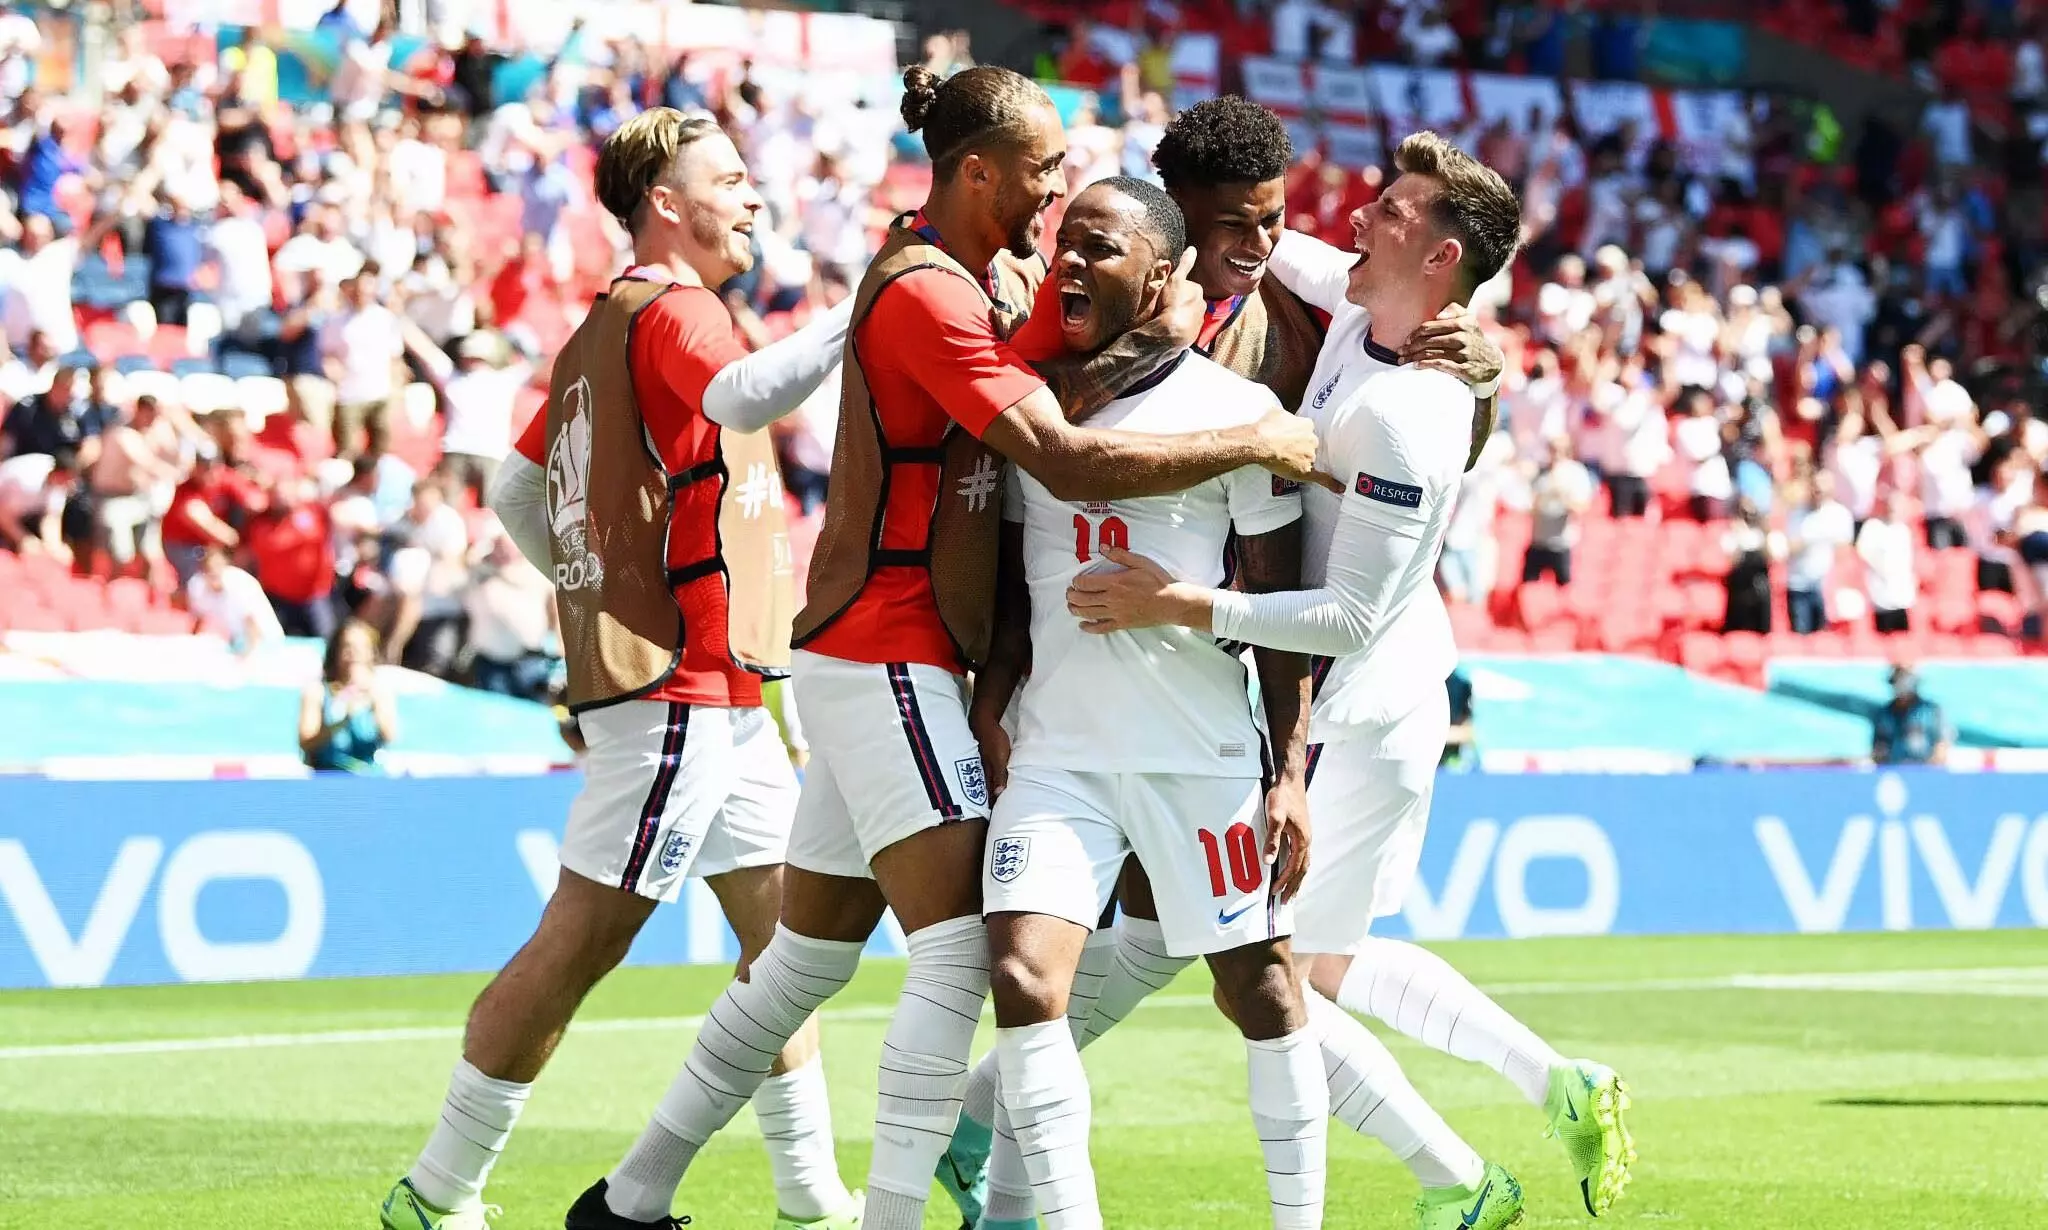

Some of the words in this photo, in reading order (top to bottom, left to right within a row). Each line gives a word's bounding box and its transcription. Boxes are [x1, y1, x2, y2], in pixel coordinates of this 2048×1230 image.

[1373, 484, 1421, 503] RESPECT
[1073, 513, 1129, 564] 10
[1198, 821, 1263, 897] 10
[1752, 771, 2048, 934] viv
